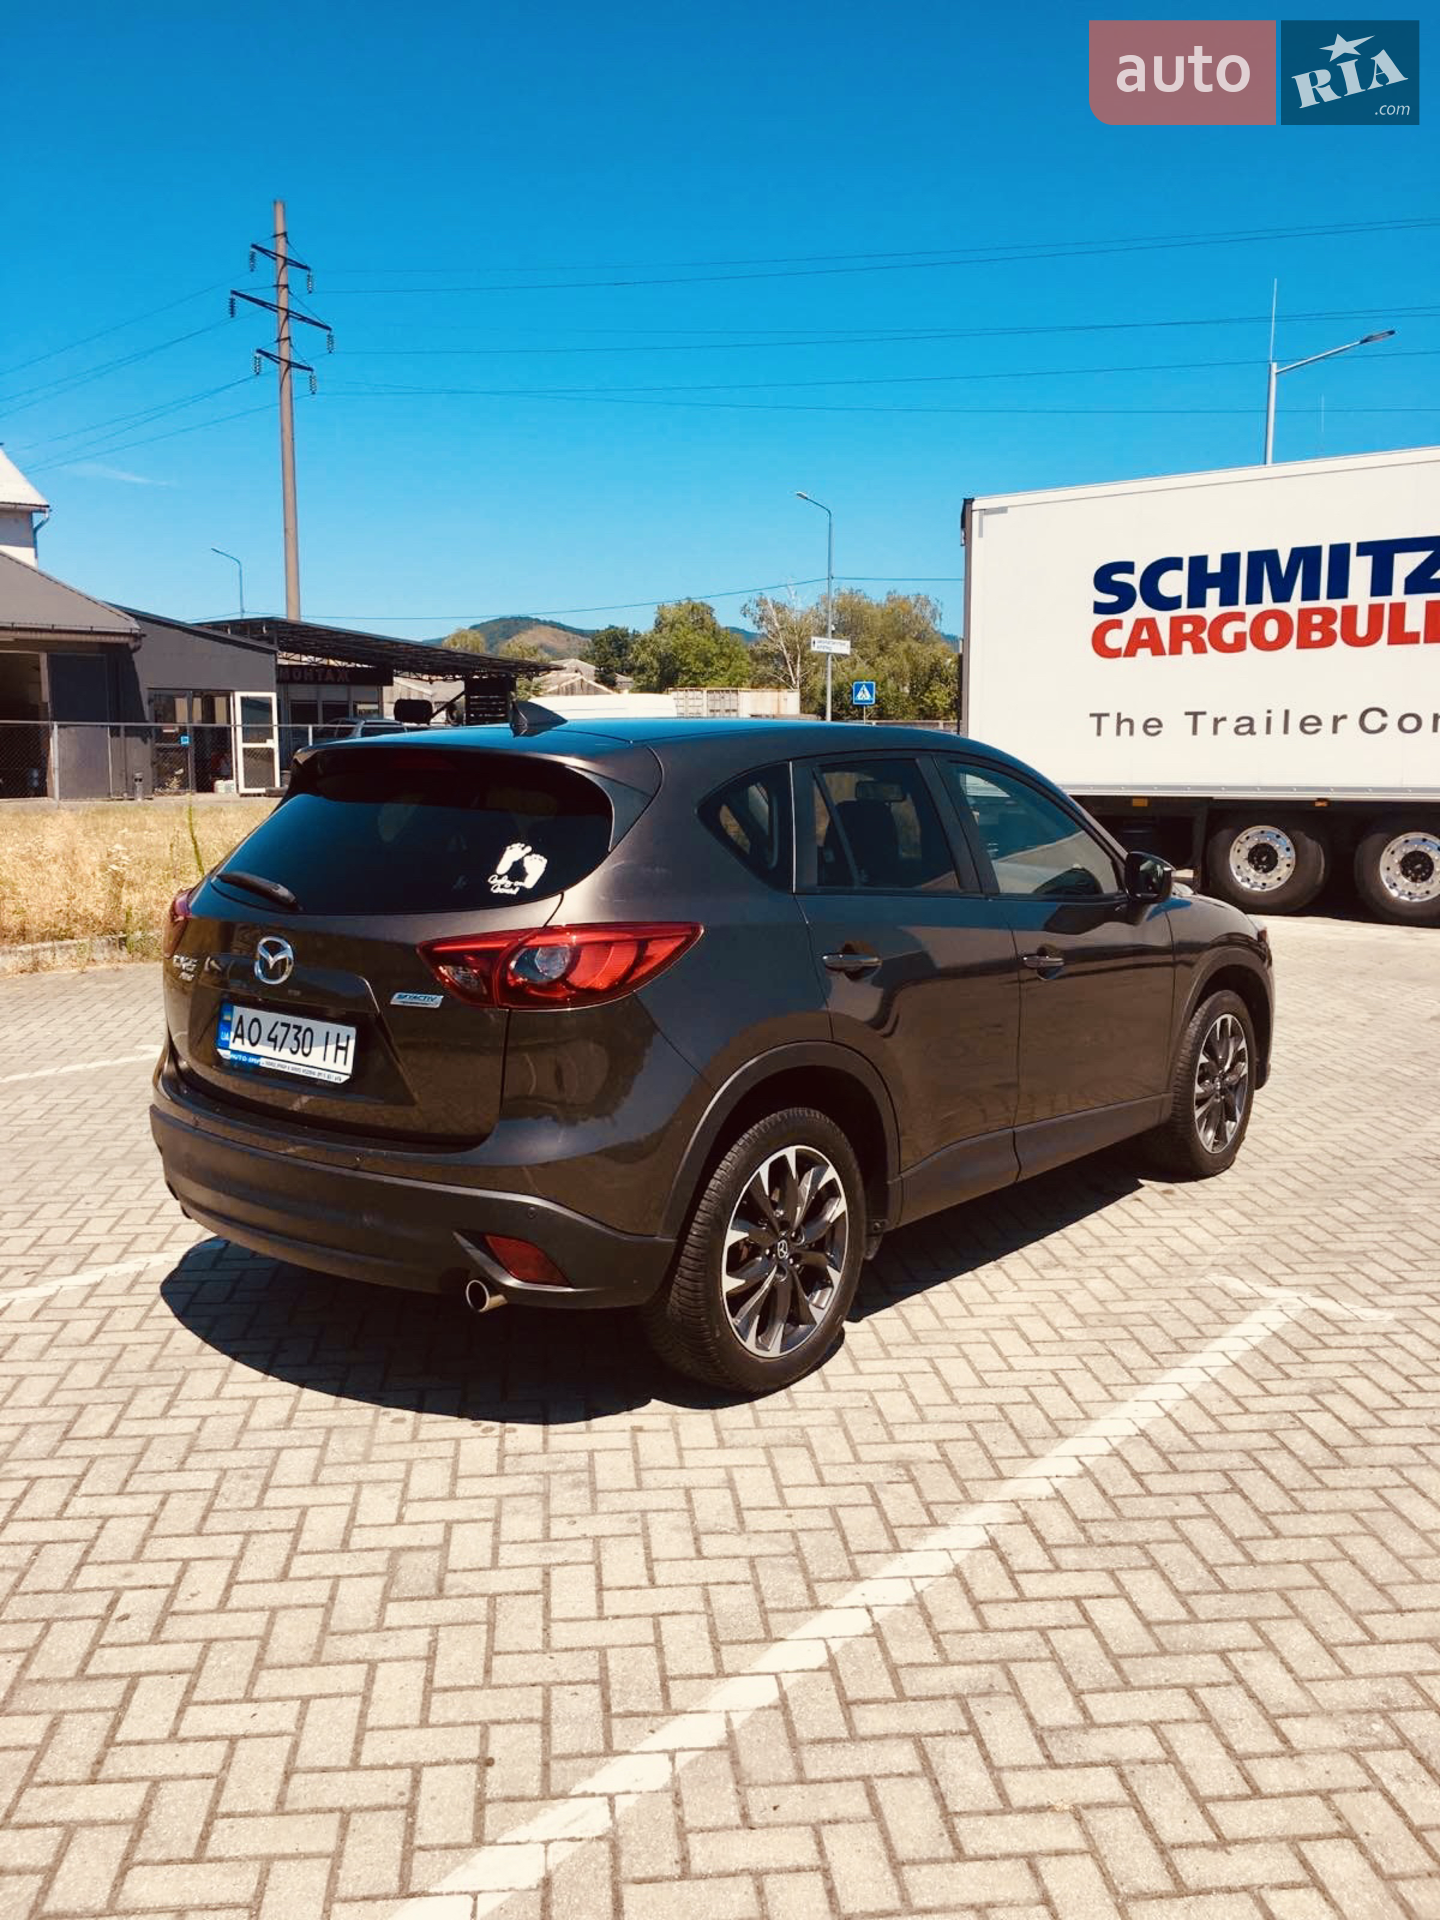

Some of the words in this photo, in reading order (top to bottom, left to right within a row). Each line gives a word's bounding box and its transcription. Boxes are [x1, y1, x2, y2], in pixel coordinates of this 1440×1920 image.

[1089, 712, 1164, 737] The
[232, 1014, 262, 1047] AO
[267, 1021, 314, 1057] 4730
[323, 1031, 350, 1066] IH
